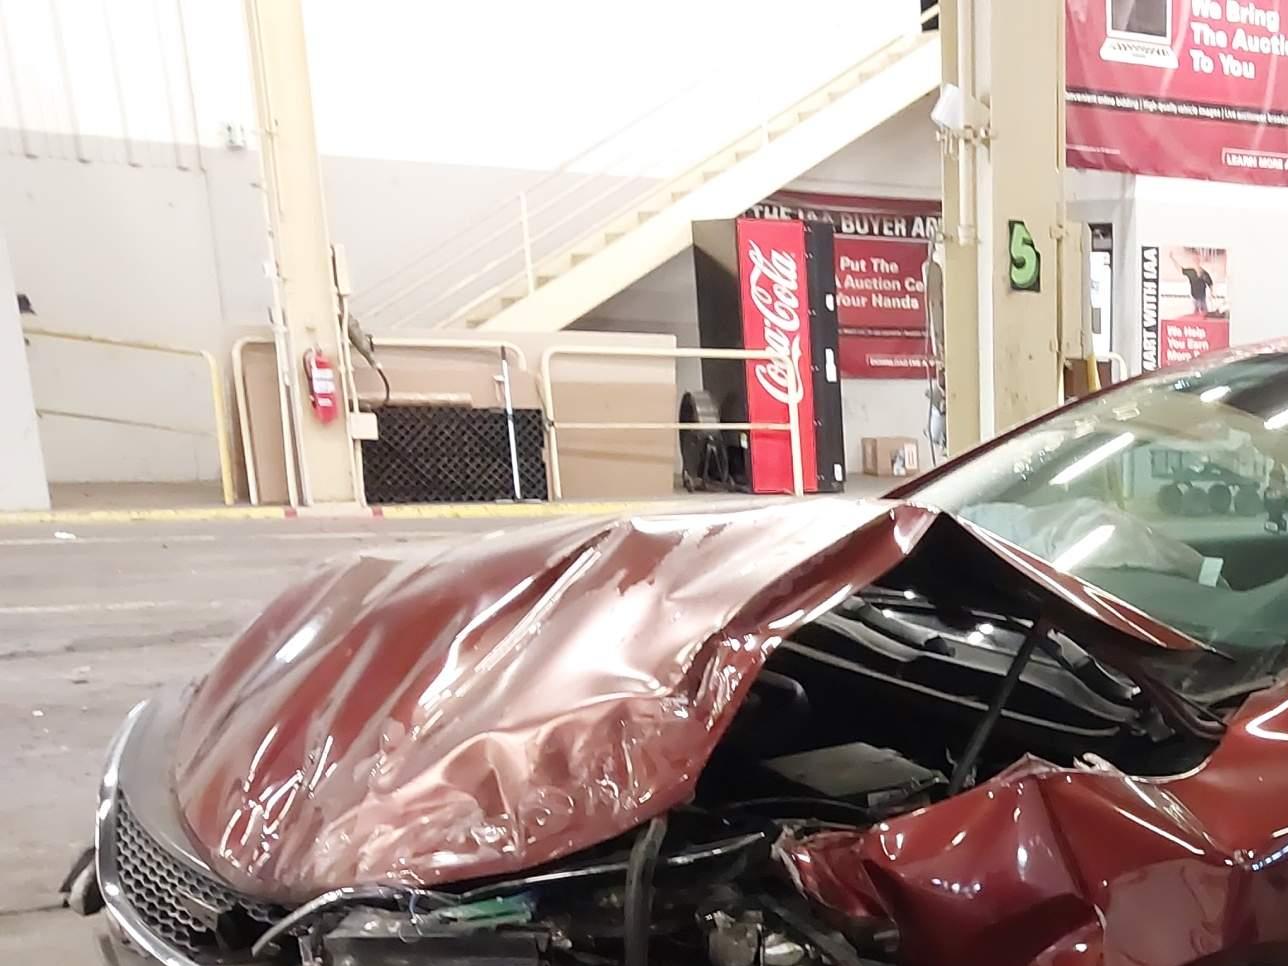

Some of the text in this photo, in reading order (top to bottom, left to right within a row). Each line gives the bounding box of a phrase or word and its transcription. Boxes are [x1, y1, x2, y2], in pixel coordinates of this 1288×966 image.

[1190, 0, 1280, 33] We Bring
[1190, 23, 1229, 49] The
[1190, 50, 1256, 80] To You
[841, 214, 907, 237] BUYER
[839, 256, 900, 273] Put The
[1010, 222, 1039, 288] 5
[1143, 248, 1158, 279] IAA
[843, 275, 902, 292] Auction
[872, 293, 920, 310] Hands
[1143, 281, 1157, 325] WITH
